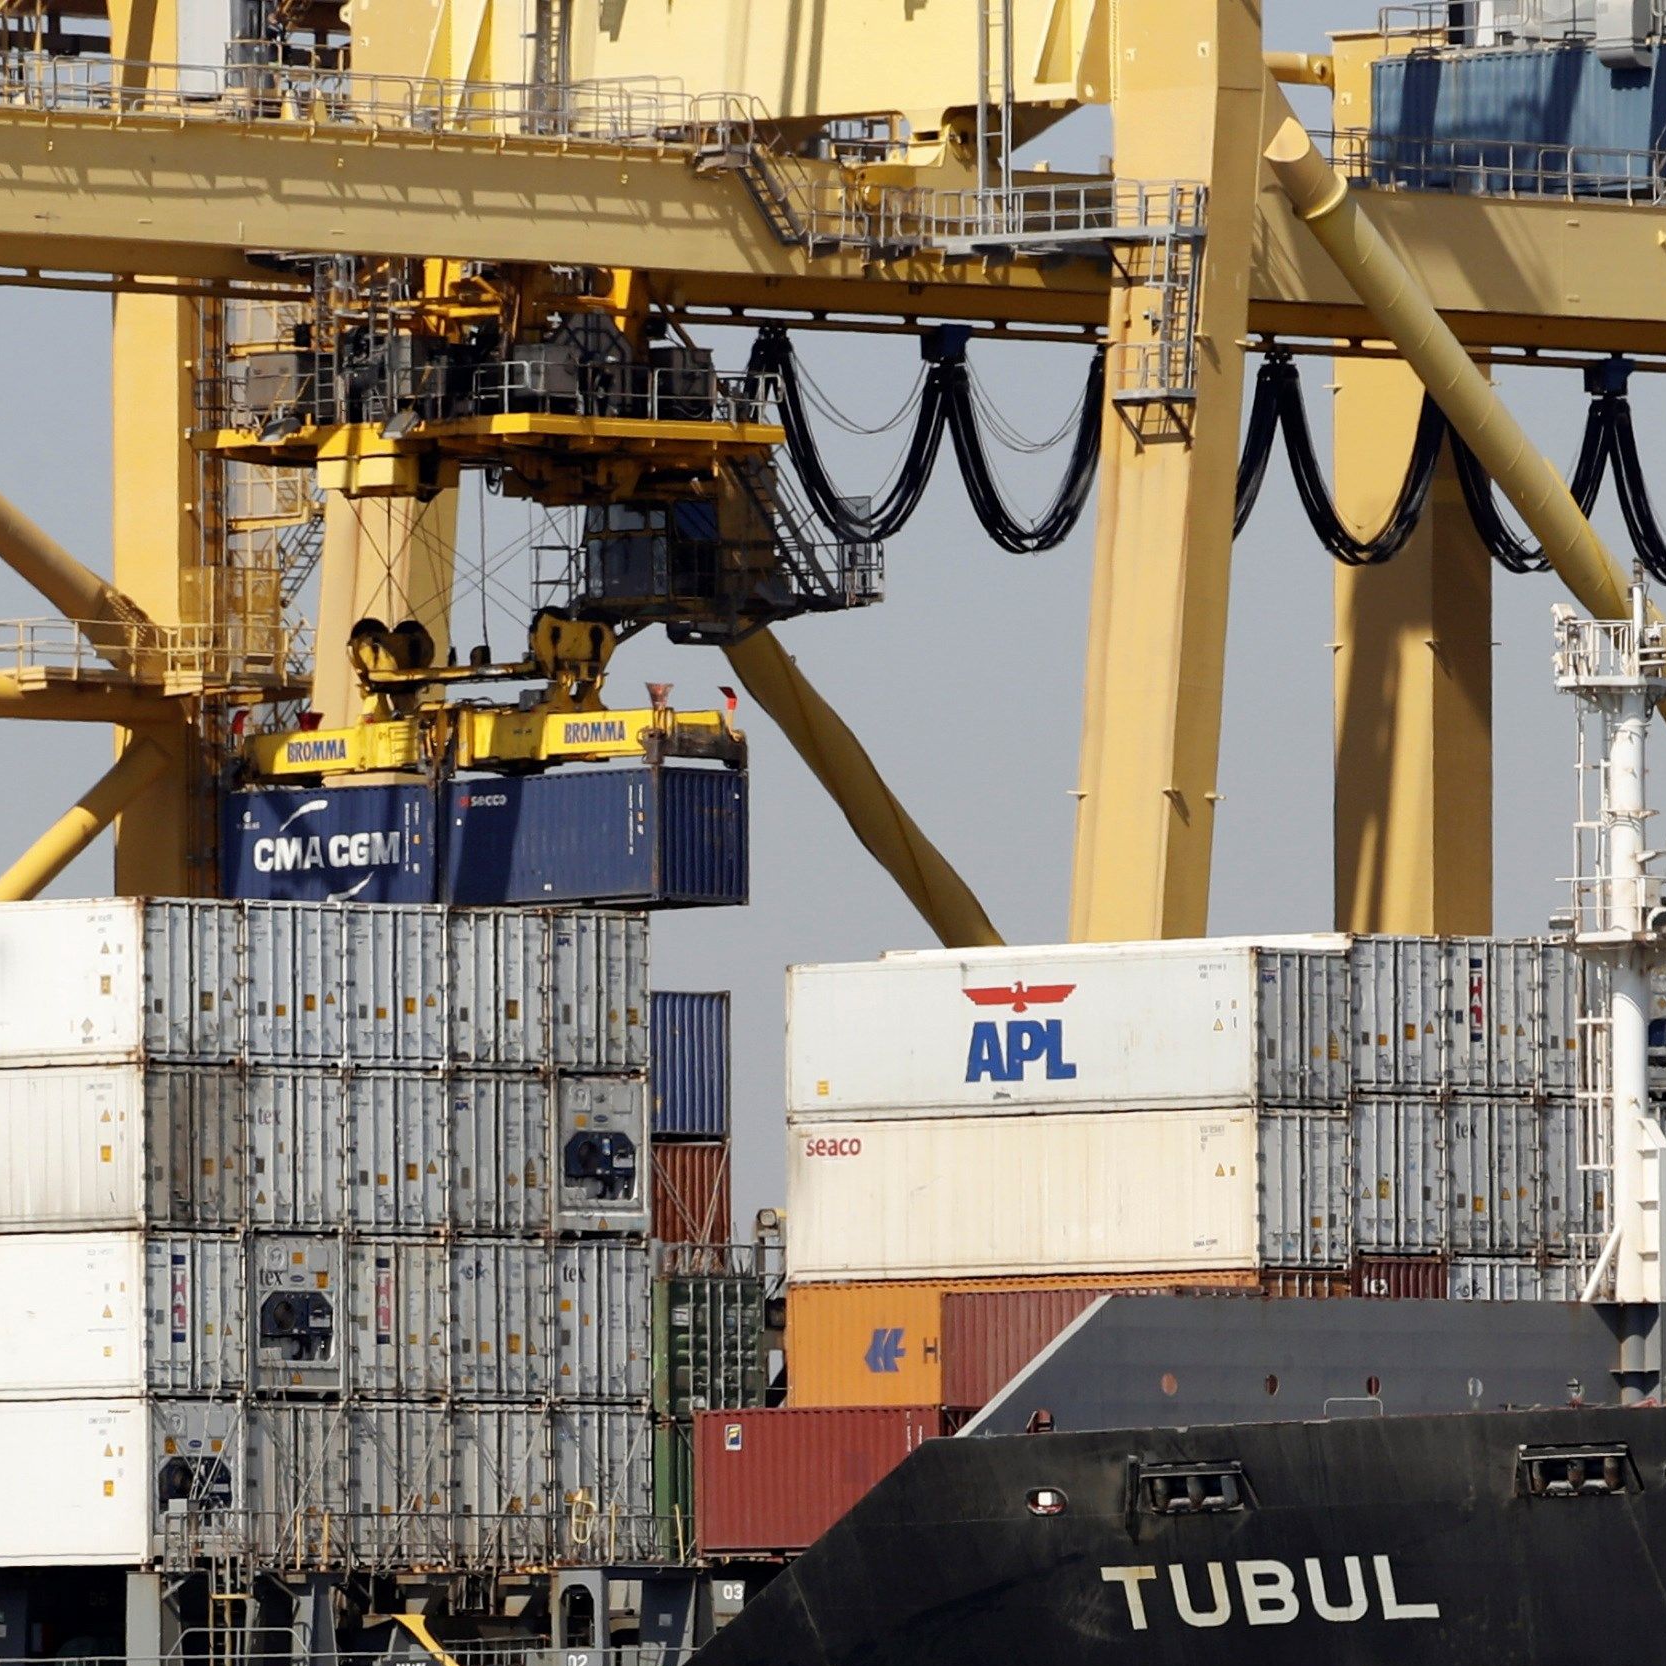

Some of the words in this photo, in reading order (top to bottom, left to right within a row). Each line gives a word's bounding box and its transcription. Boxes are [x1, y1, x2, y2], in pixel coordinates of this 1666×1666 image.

[564, 721, 626, 744] BROMMA
[286, 738, 347, 763] BROMMA
[253, 833, 325, 872] CMA
[328, 831, 401, 869] CGM
[964, 1018, 1077, 1084] APL
[257, 1106, 284, 1126] tex
[805, 1136, 862, 1158] seaco
[259, 1267, 284, 1287] tex
[562, 1263, 588, 1284] tex
[171, 1270, 187, 1331] TAL
[376, 1271, 392, 1332] TAL
[1100, 1554, 1441, 1631] TUBUL
